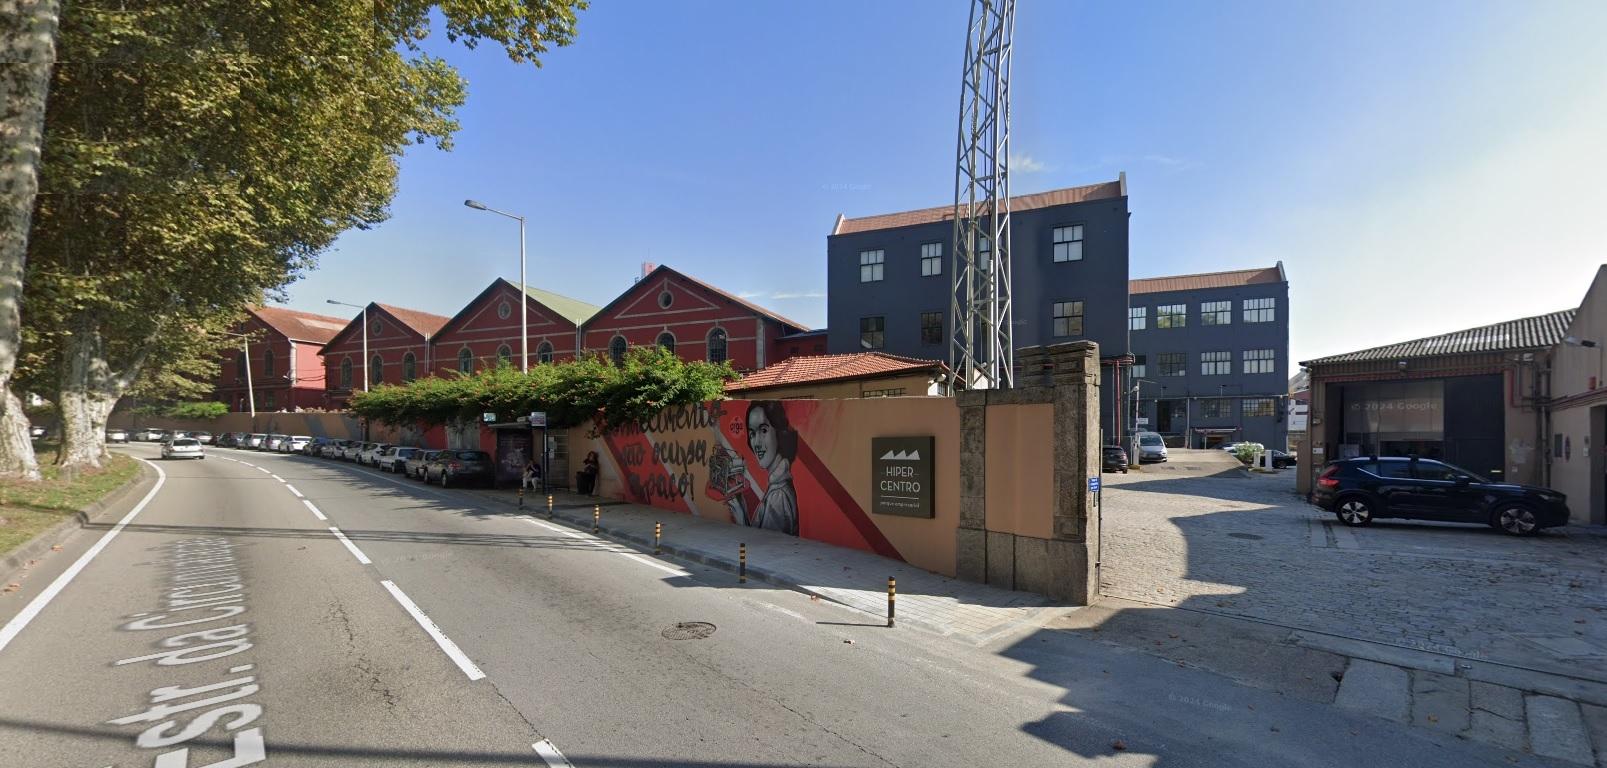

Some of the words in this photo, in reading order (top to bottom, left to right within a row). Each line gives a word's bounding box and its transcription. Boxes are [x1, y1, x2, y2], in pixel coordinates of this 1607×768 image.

[652, 440, 707, 474] ocupa
[886, 466, 914, 478] HIPER
[628, 472, 694, 502] paço!
[880, 480, 920, 493] CENTRO
